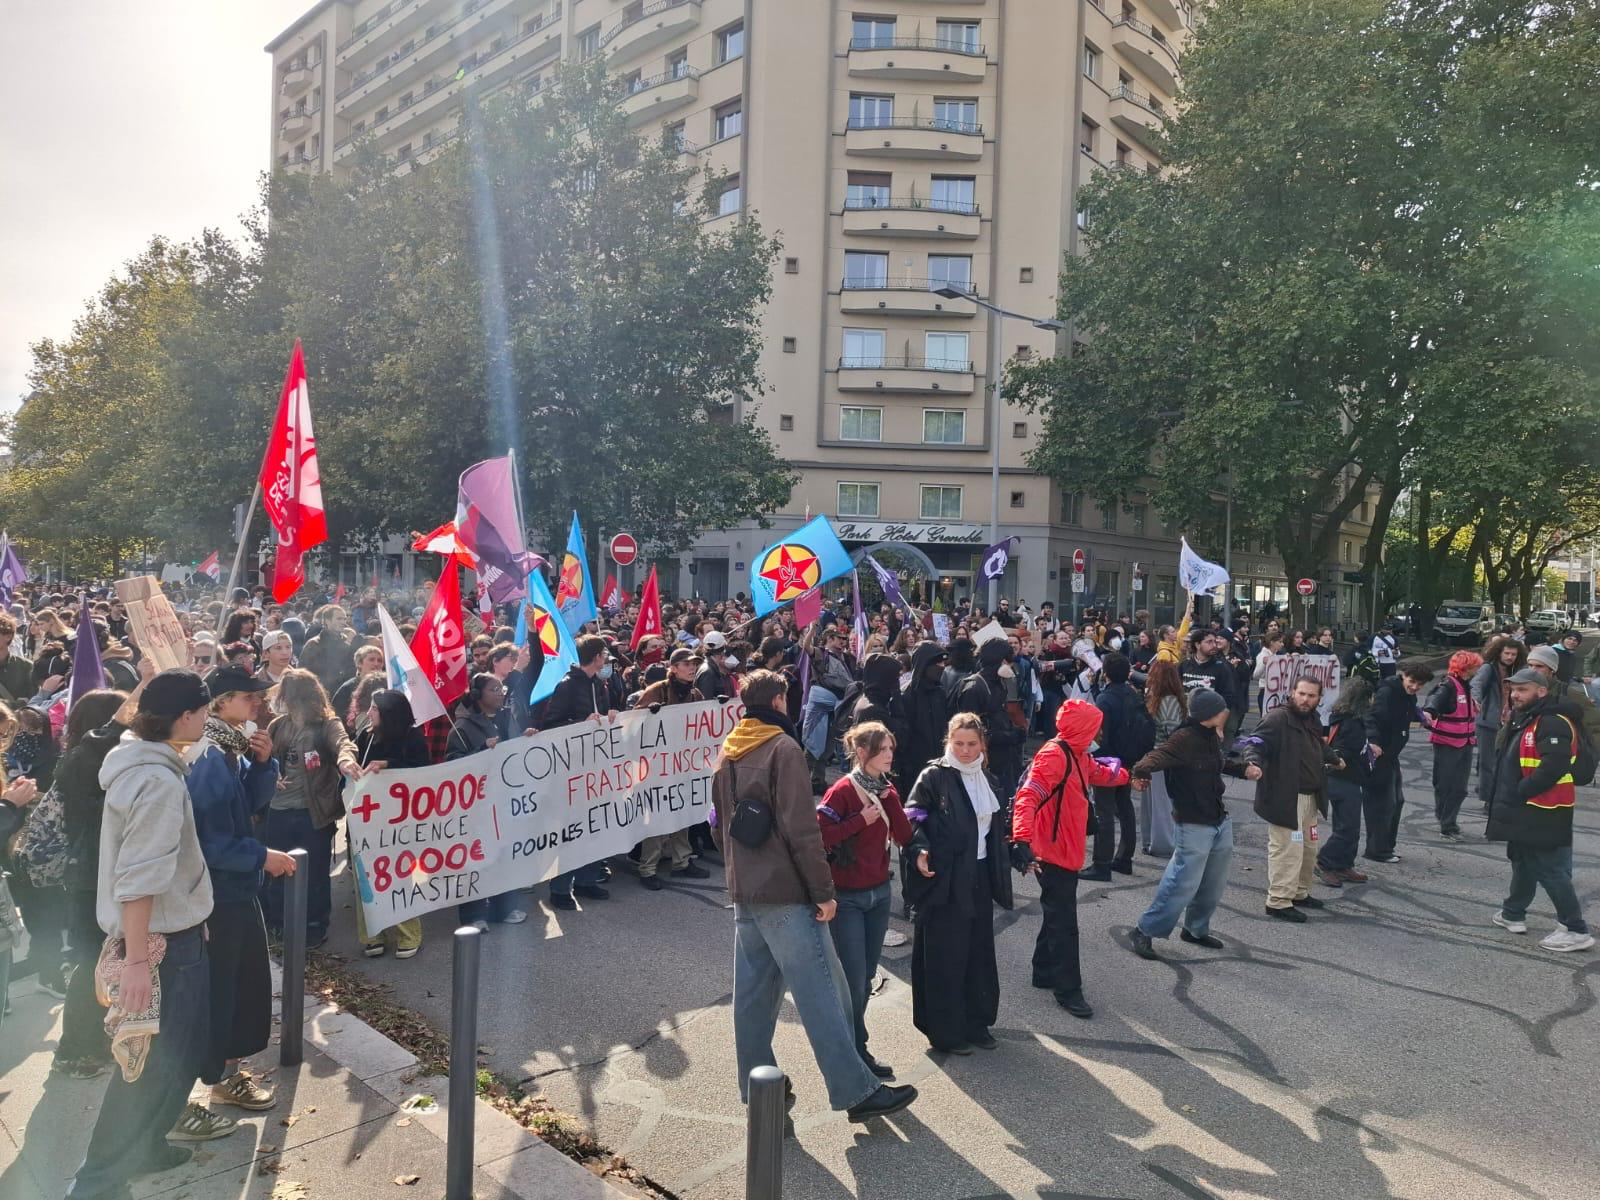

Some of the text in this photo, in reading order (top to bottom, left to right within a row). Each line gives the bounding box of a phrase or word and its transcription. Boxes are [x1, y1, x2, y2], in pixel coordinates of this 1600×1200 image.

[838, 524, 983, 542] Park Hôtel Grenoble
[501, 725, 625, 788] CONTRE
[640, 719, 667, 749] LA
[351, 773, 487, 824] + 9000€
[511, 791, 537, 816] DES
[568, 760, 632, 807] FRAIS
[380, 814, 468, 849] LICENCE
[512, 831, 558, 860] POUR
[562, 821, 584, 843] LES
[691, 775, 710, 806] ET
[373, 838, 485, 892] 8000€
[391, 870, 480, 911] MASTER
